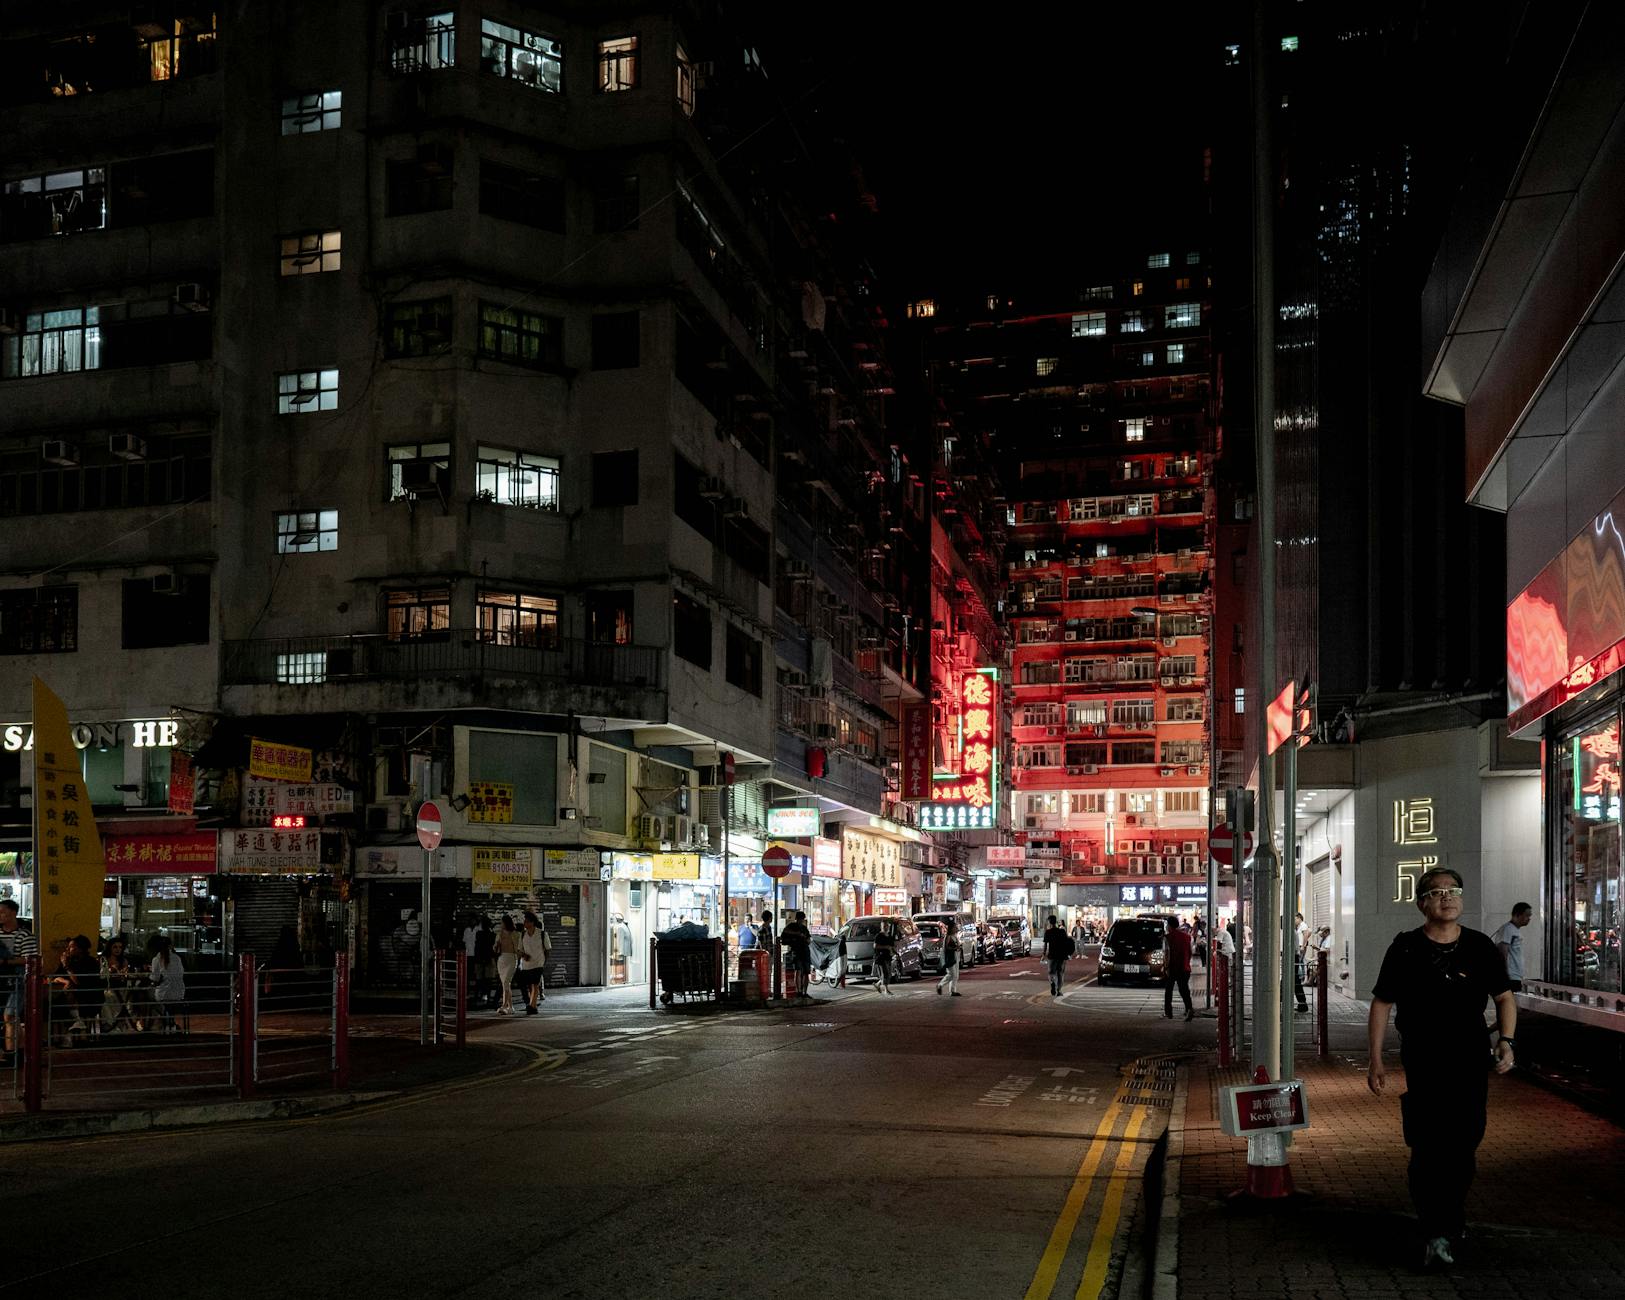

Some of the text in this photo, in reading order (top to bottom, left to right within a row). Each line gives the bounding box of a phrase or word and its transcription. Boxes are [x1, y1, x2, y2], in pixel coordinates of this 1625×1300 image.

[4, 723, 119, 751] SON
[321, 787, 342, 801] LED
[236, 832, 318, 852] 華通電器行
[1250, 1109, 1296, 1122] Keep Clear
